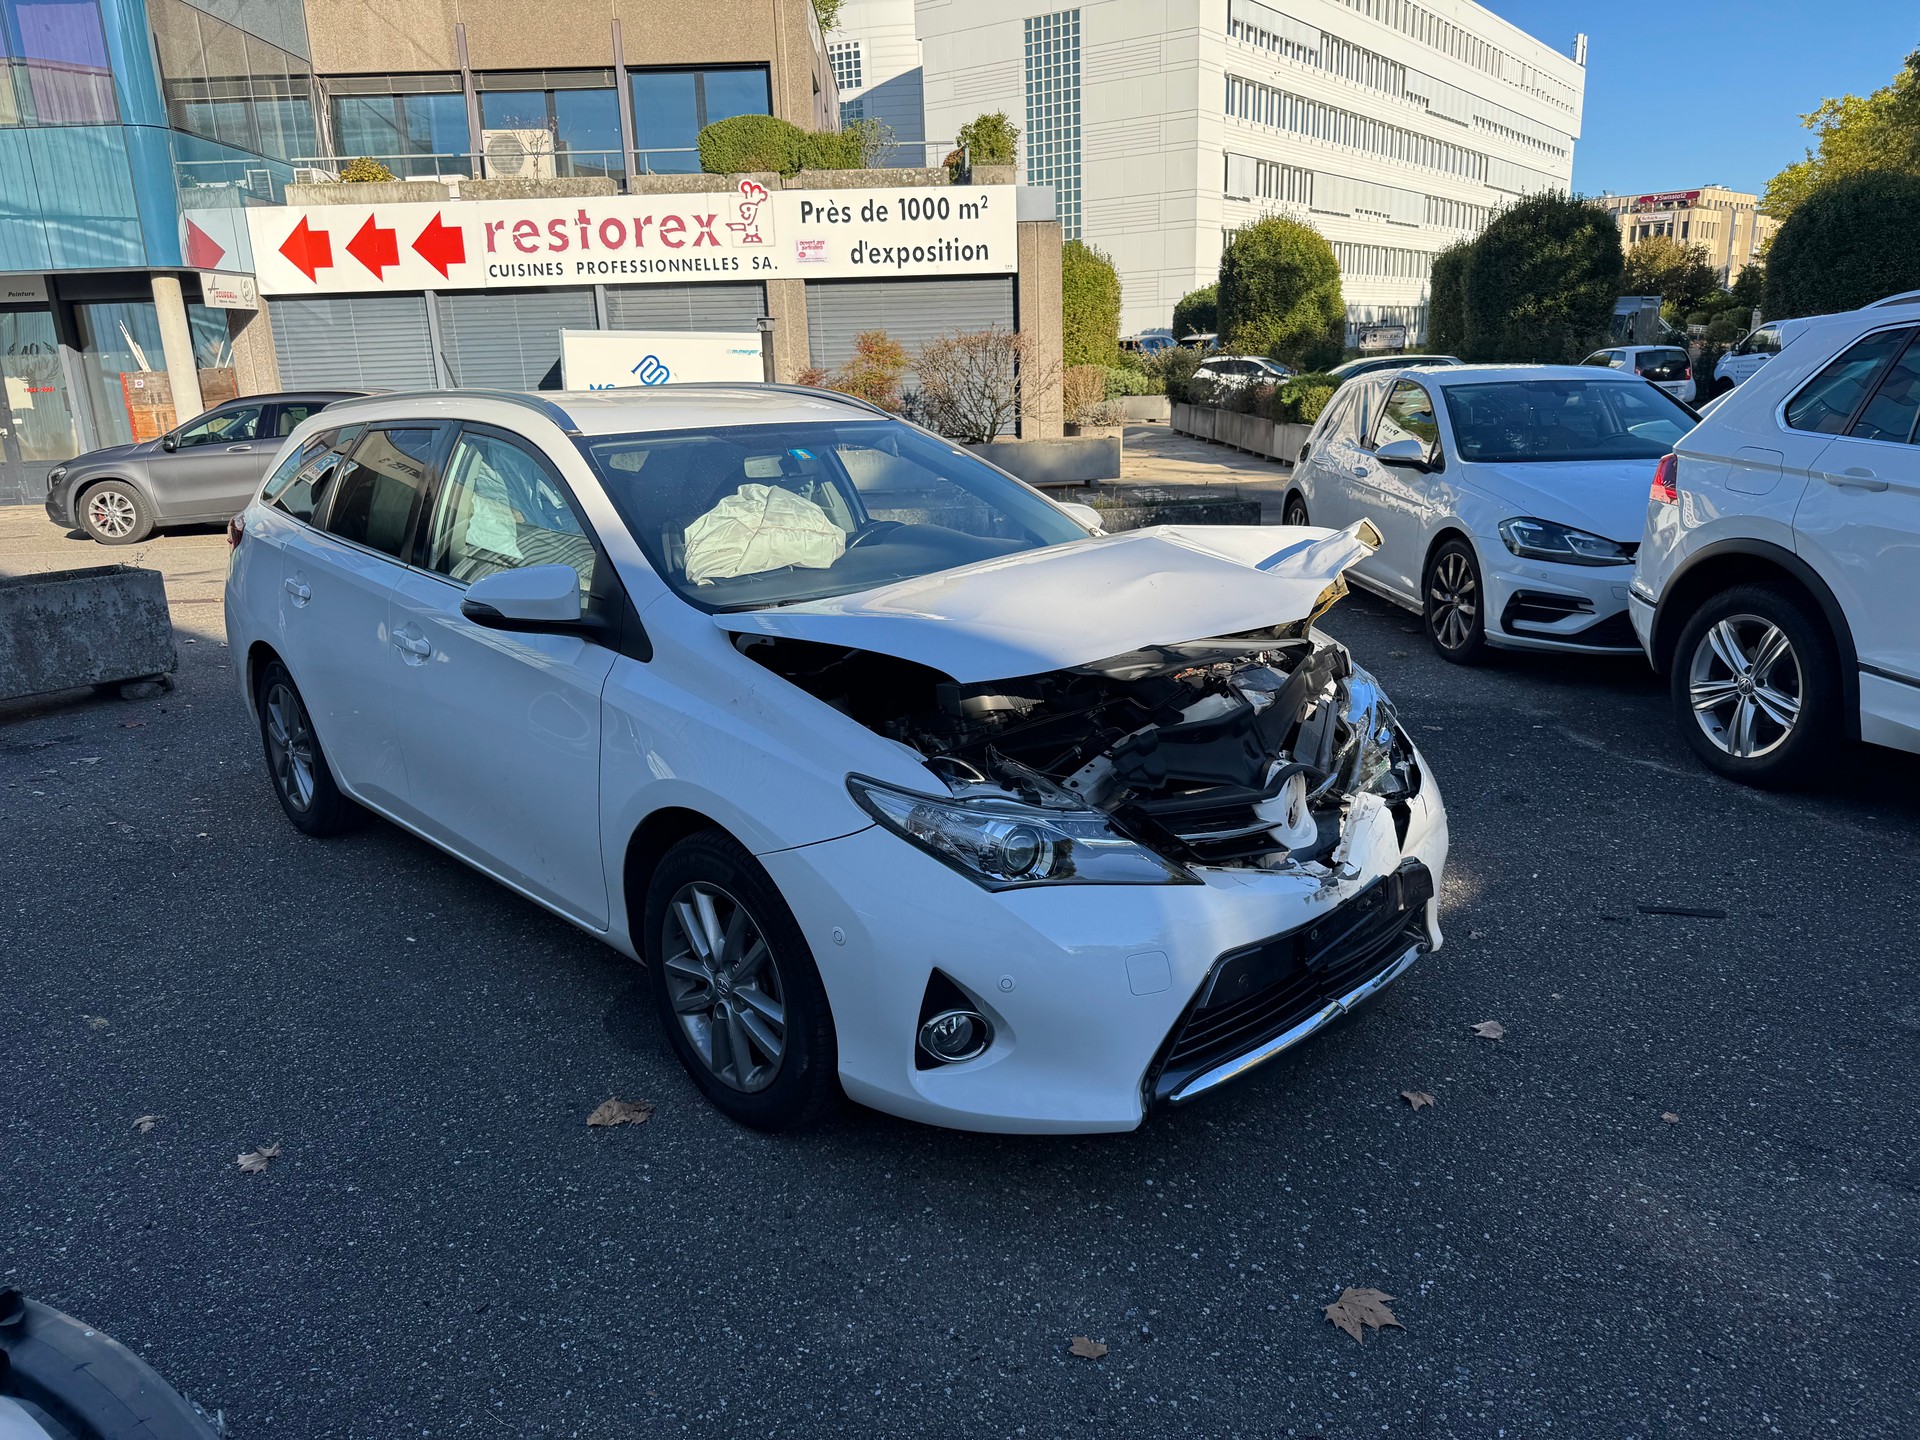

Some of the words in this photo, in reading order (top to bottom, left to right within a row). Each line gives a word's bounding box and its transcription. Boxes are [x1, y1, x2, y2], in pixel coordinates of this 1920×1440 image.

[800, 199, 851, 224] Près
[860, 198, 889, 222] de
[898, 197, 950, 221] 1000
[484, 208, 723, 254] restorex
[488, 262, 564, 278] CUISINES
[576, 257, 740, 275] PROFESSIONNELLES
[850, 237, 989, 269] d'exposition
